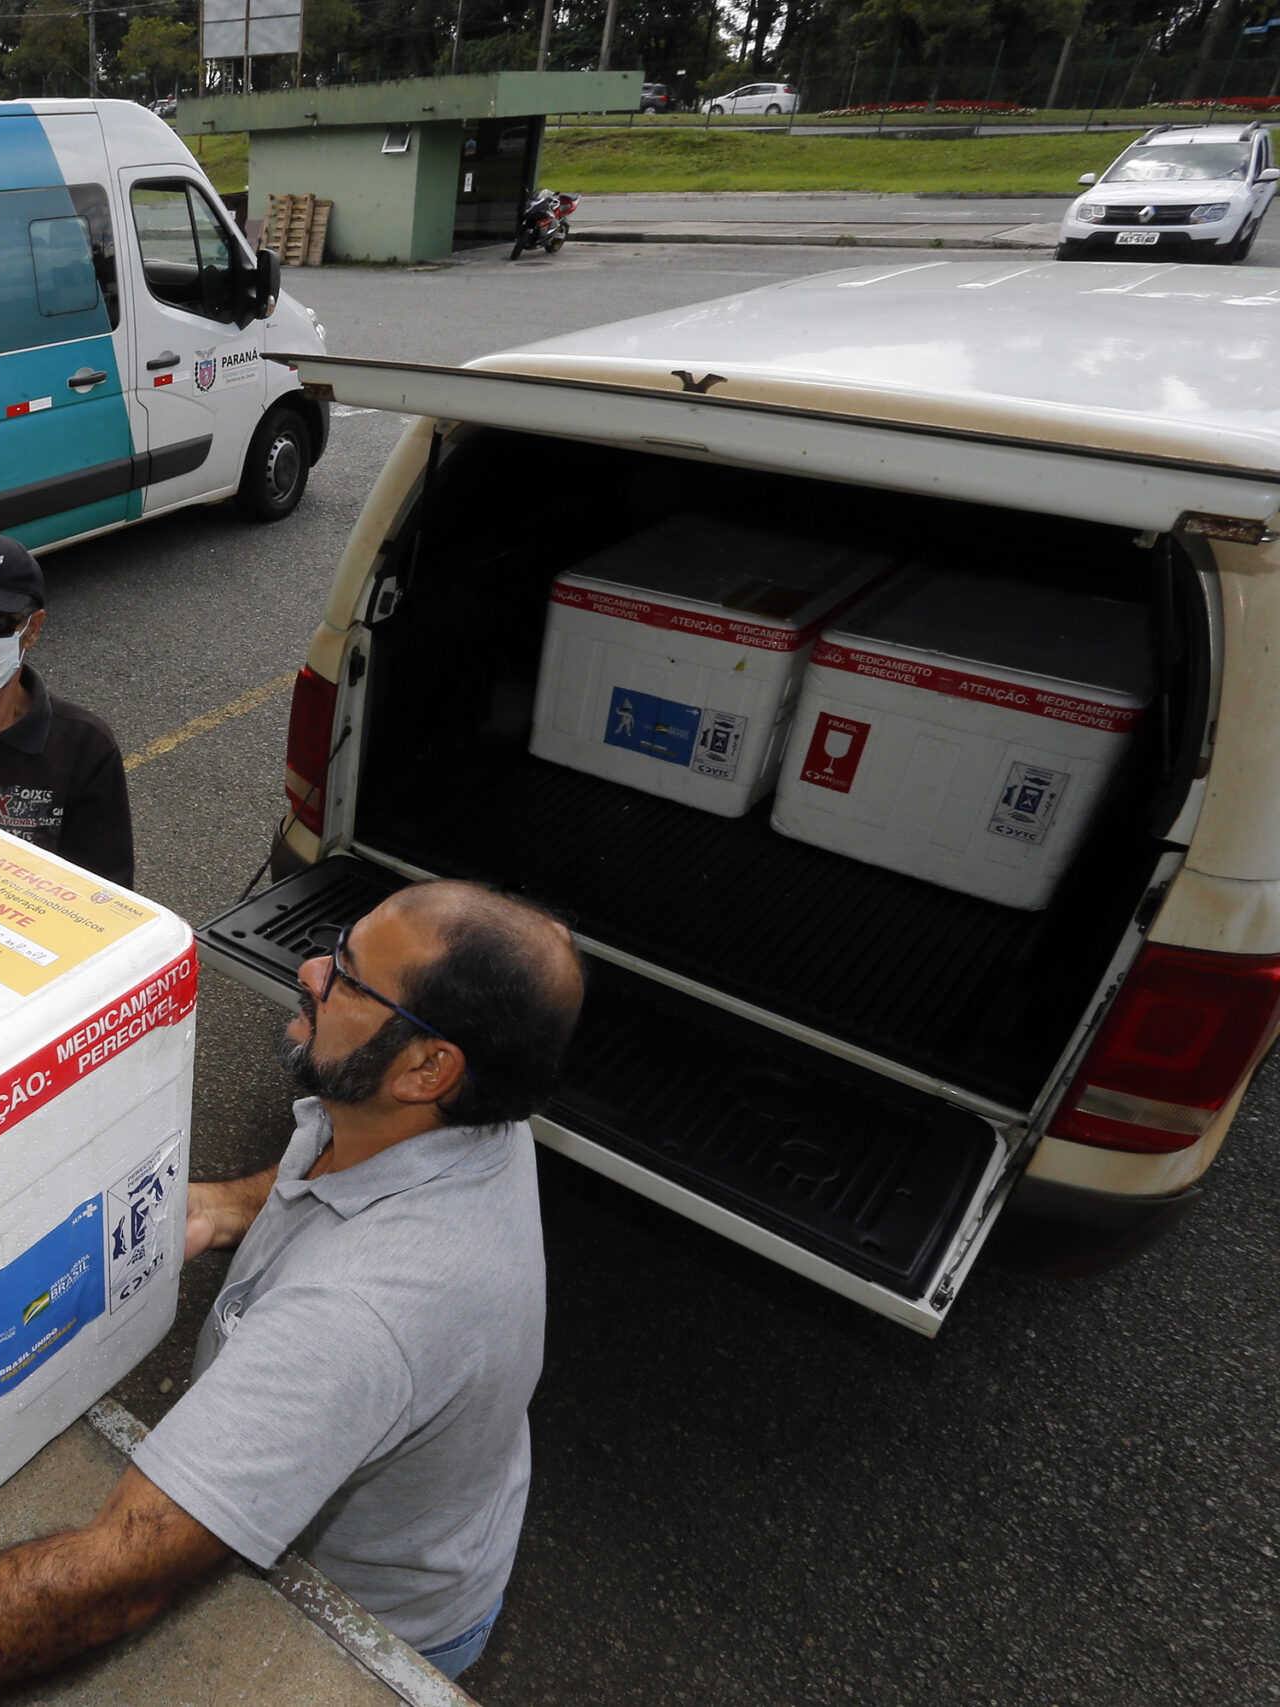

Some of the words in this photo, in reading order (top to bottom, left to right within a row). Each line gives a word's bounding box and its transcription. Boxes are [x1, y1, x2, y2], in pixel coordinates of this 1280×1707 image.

[221, 346, 258, 368] PARANÁ
[587, 592, 651, 613] MEDICAMENTO
[850, 652, 933, 677] MEDICAMENTO
[958, 682, 1030, 705] ATENÇÃO:
[1036, 694, 1133, 721] MEDICAMENTO
[0, 878, 25, 891] e/ou
[56, 959, 190, 1064] MEDICAMENTO
[78, 995, 178, 1074] PERECÍVEL
[50, 1261, 89, 1300] BRASIL
[0, 1352, 31, 1377] BRASIL
[31, 1328, 58, 1352] UNIDO
